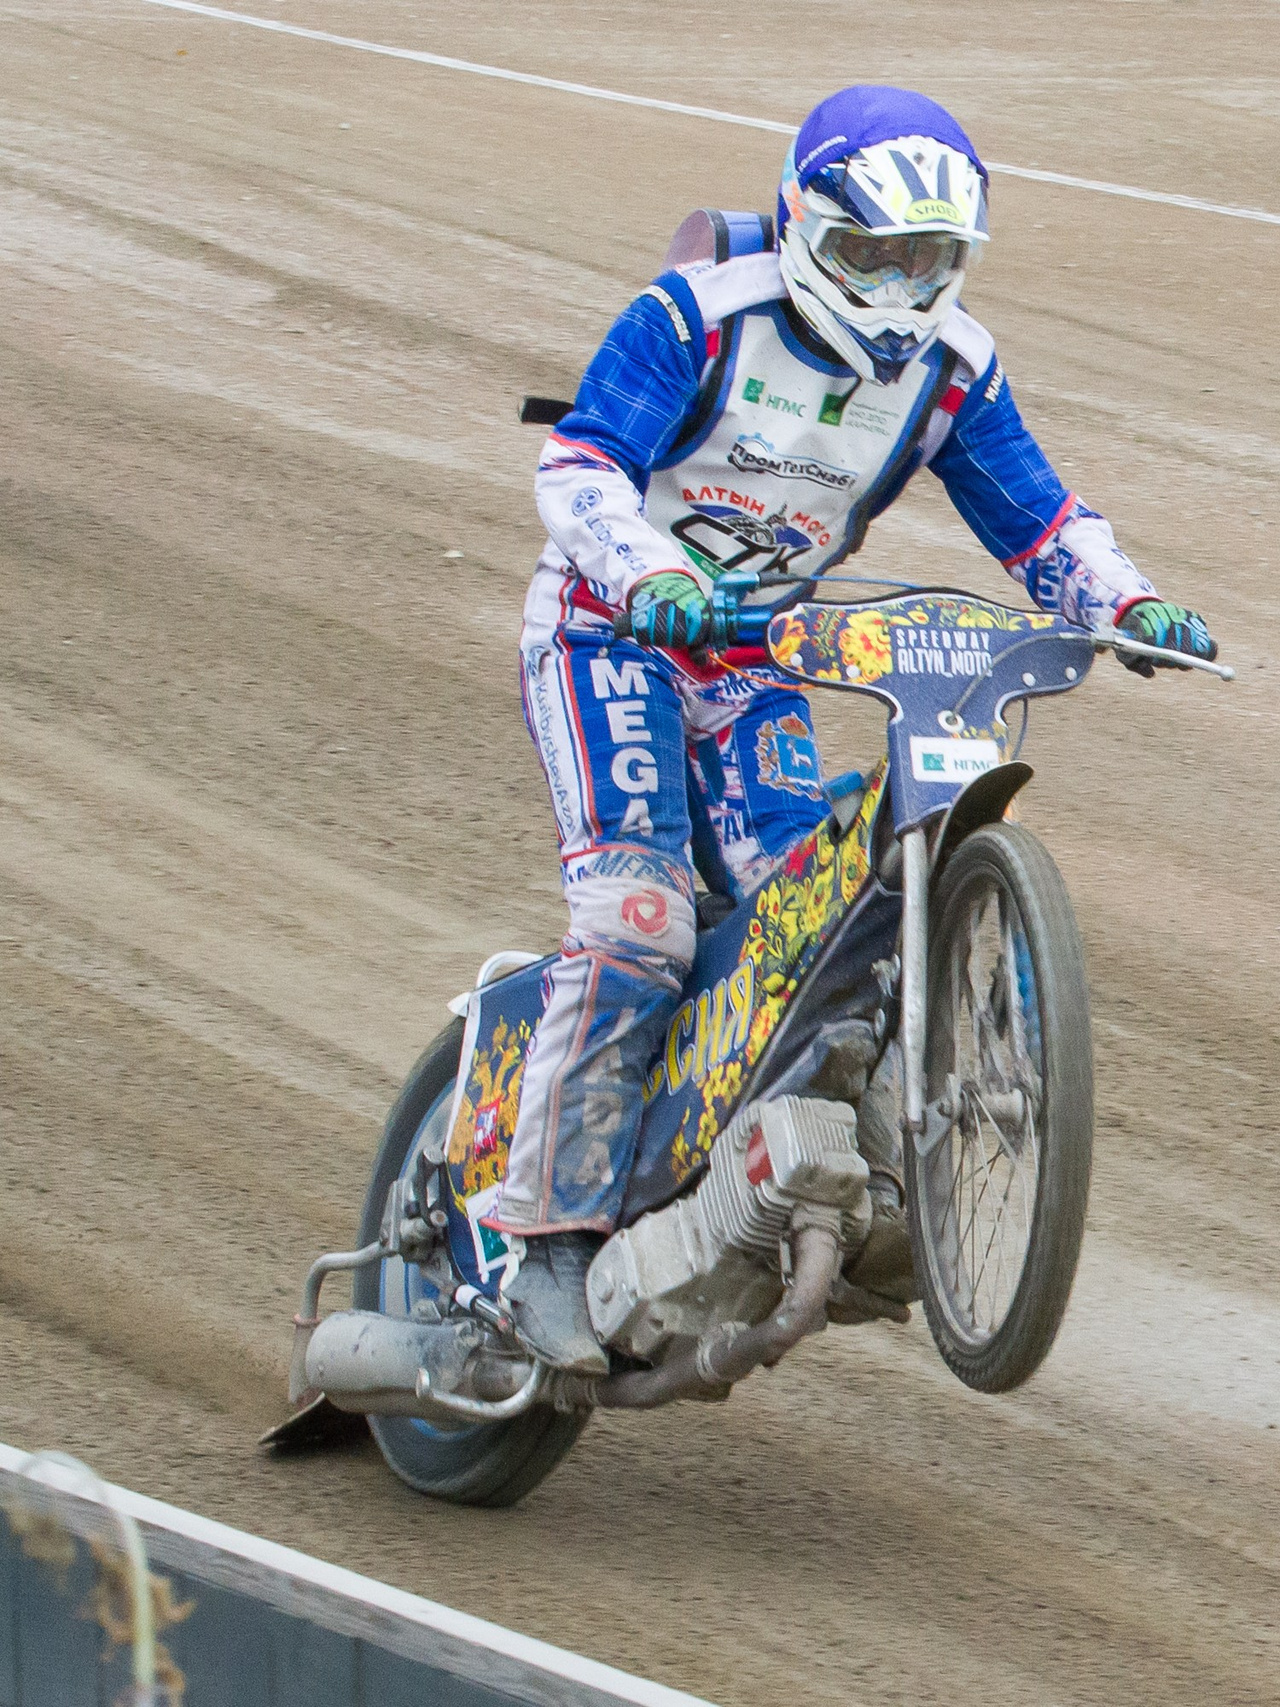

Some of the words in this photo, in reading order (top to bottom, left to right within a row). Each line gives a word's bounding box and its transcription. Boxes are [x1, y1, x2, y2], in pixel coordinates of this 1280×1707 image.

[682, 486, 765, 516] АЛТЫН
[895, 628, 990, 650] SPEEDWAY
[589, 657, 659, 838] MEGA
